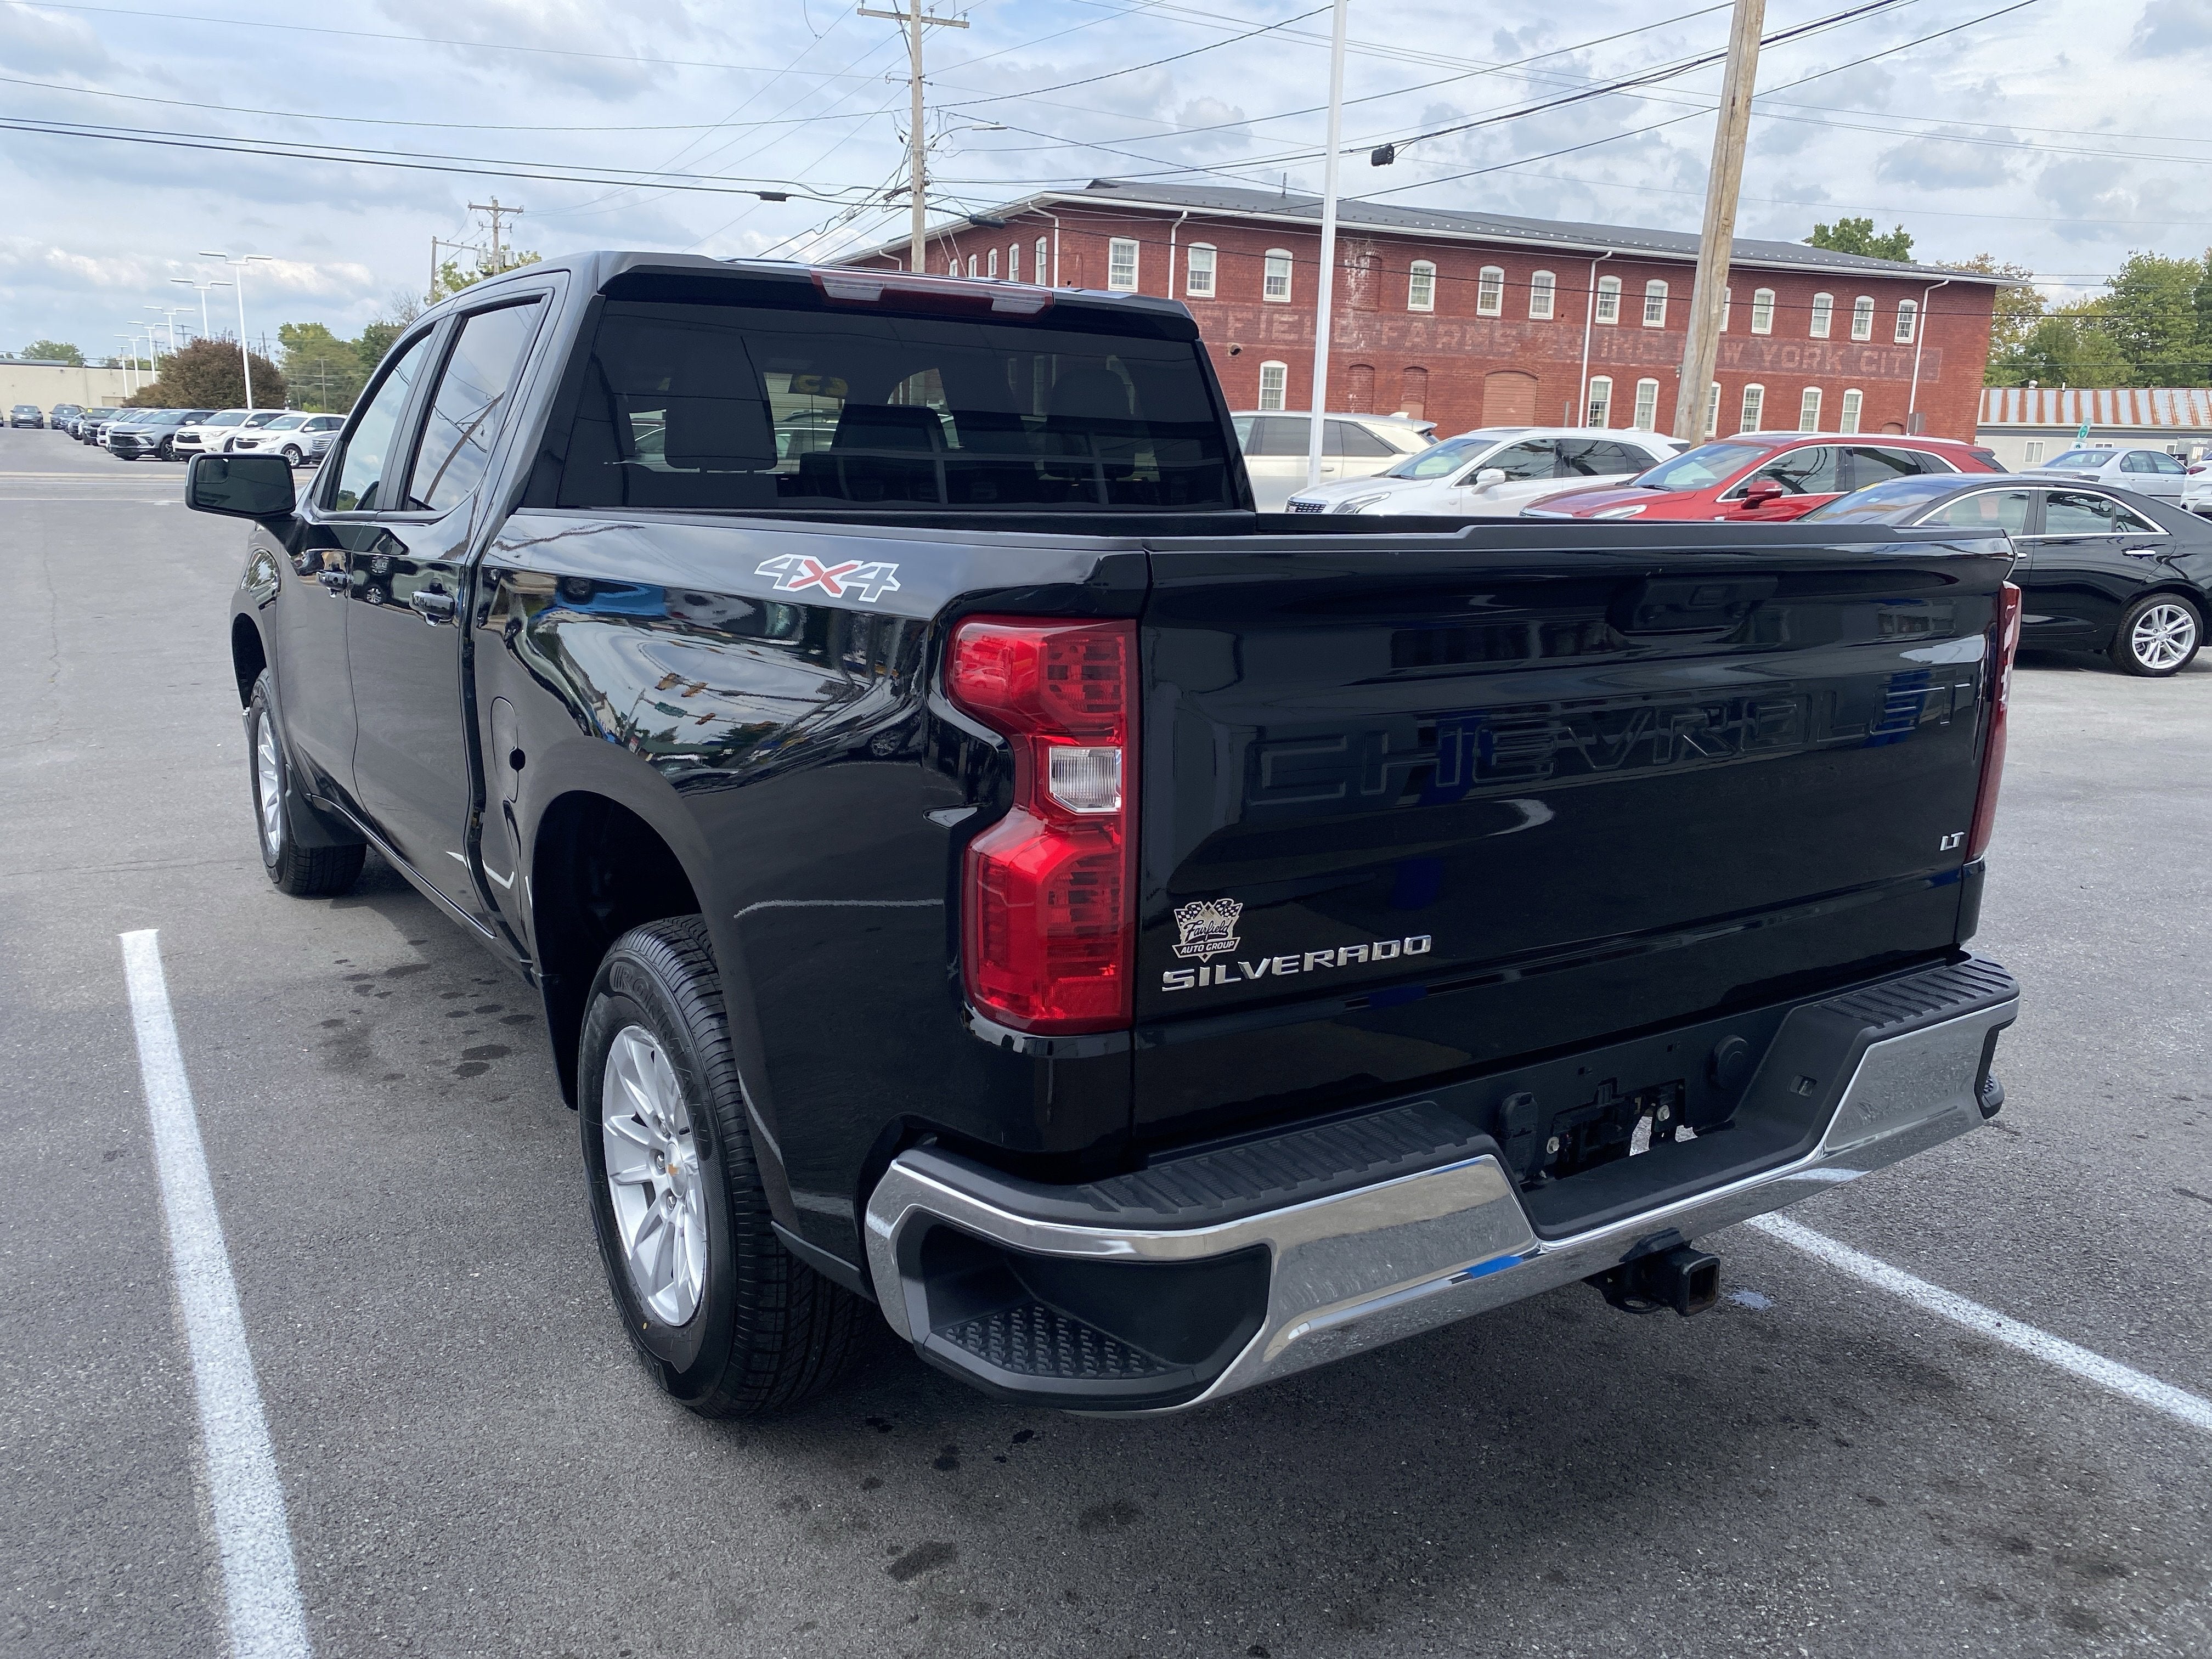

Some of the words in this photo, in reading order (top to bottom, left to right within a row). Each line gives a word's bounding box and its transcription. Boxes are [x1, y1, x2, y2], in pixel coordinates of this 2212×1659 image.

[1762, 344, 1844, 373] YORK
[1860, 350, 1927, 375] CITY
[1245, 679, 1974, 808] CHEVROLET
[1940, 832, 1965, 851] LT
[1183, 919, 1233, 943] Fairfield
[1180, 944, 1204, 955] AUTO
[1206, 940, 1235, 951] GROUP
[1161, 934, 1432, 992] SILVERADO
